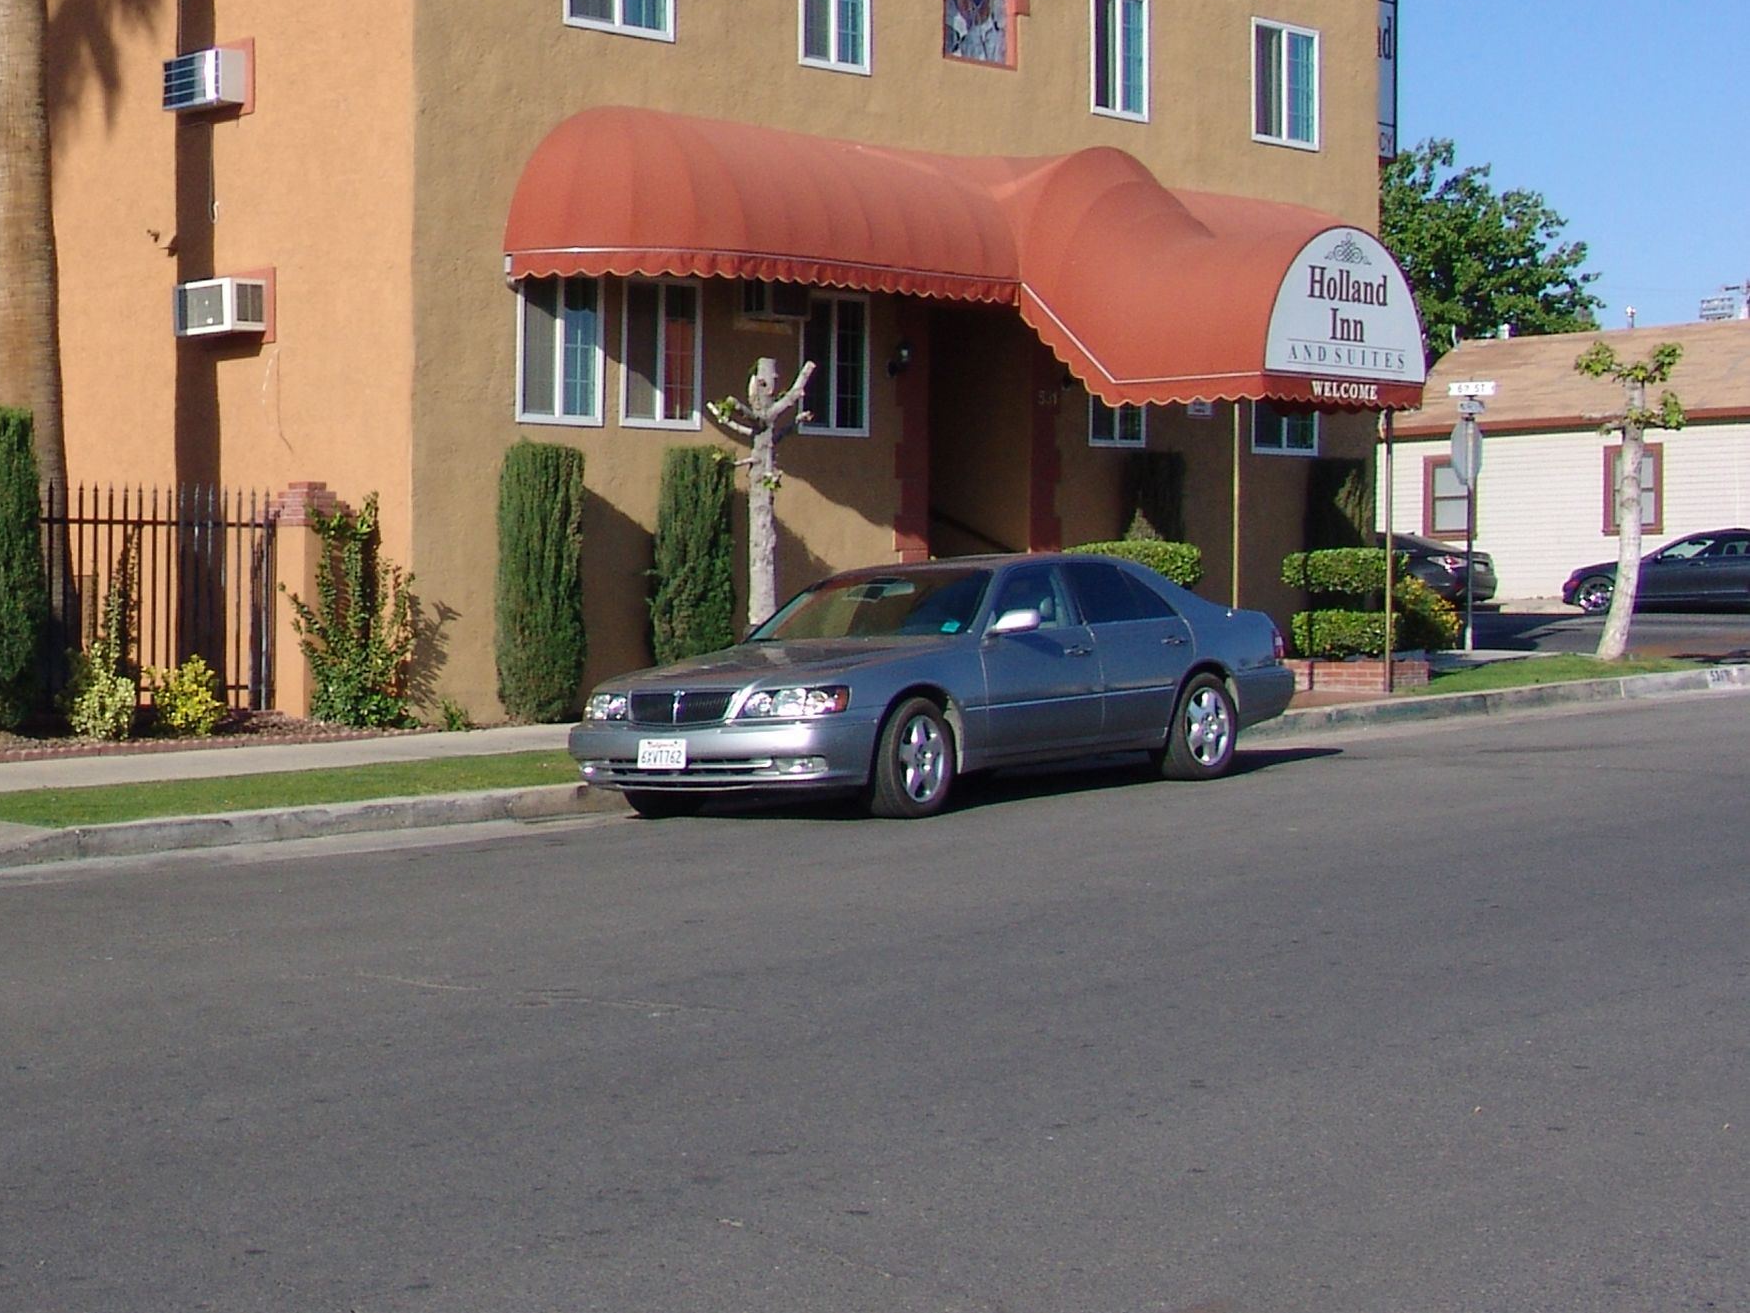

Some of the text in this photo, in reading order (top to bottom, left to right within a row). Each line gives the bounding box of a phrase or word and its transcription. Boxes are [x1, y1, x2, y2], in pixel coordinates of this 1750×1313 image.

[1307, 265, 1389, 306] Holland
[1330, 308, 1364, 343] Inn
[1288, 344, 1405, 369] AND SUITES
[1311, 380, 1378, 400] WELCOME
